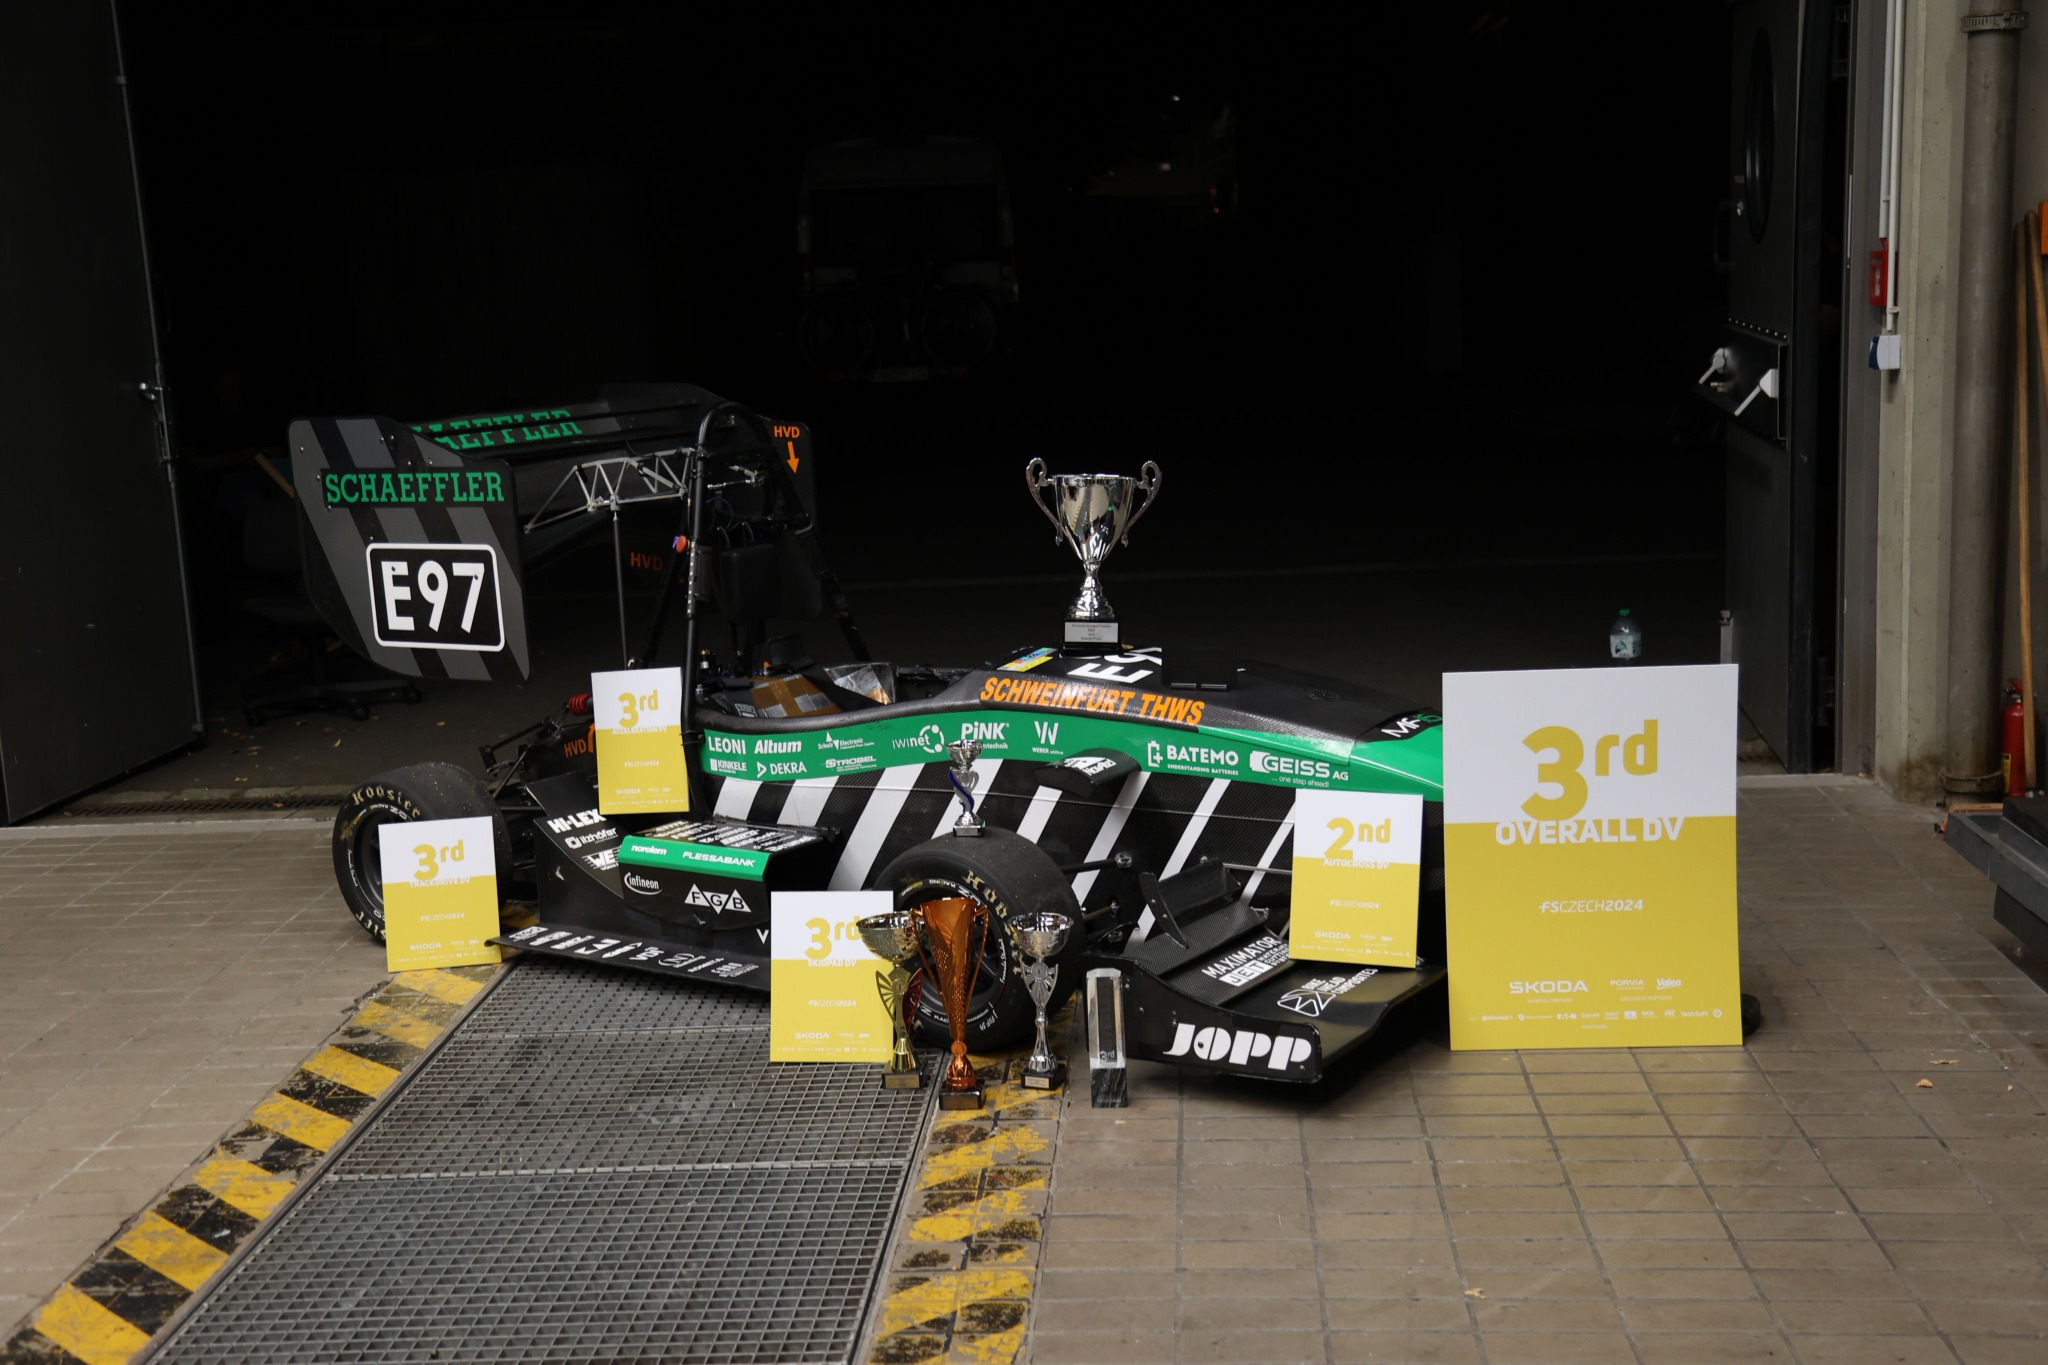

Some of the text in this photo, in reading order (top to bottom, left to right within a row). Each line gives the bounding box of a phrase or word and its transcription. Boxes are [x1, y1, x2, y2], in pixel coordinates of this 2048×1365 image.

[773, 425, 801, 439] HVD
[325, 471, 505, 503] SCHAEFFLER
[630, 552, 664, 572] HVD
[380, 560, 486, 633] E97
[618, 689, 659, 728] 3rd
[980, 677, 1205, 725] SCHWEINFURT THWS
[564, 738, 588, 757] HVD
[708, 736, 746, 755] LEONI
[754, 739, 802, 755] Altium
[818, 738, 863, 750] Schulz Electronic
[825, 755, 877, 768] STROBEL
[1166, 745, 1239, 766] BATEMO
[717, 760, 747, 772] KINKELE
[770, 761, 807, 775] DEKRA
[1167, 764, 1239, 776] UNDERSTANDING BATTERIES
[1262, 755, 1348, 781] GEISS AG
[1520, 718, 1659, 821] 3rd
[1292, 777, 1306, 786] step
[1324, 817, 1392, 860] 2nd
[1495, 816, 1684, 845] OVERALL DV
[630, 844, 667, 856] norelem
[682, 850, 756, 868] FLESSABANK
[412, 839, 464, 881] 3rd
[1323, 858, 1375, 869] AUTOCROSS
[629, 874, 660, 890] infineon
[804, 916, 861, 960] 3rd
[807, 958, 843, 967] SKIDPAD
[1201, 936, 1281, 978] MAXIMATOR
[1656, 978, 1682, 988] Valeo
[1163, 1022, 1312, 1071] JOPP
